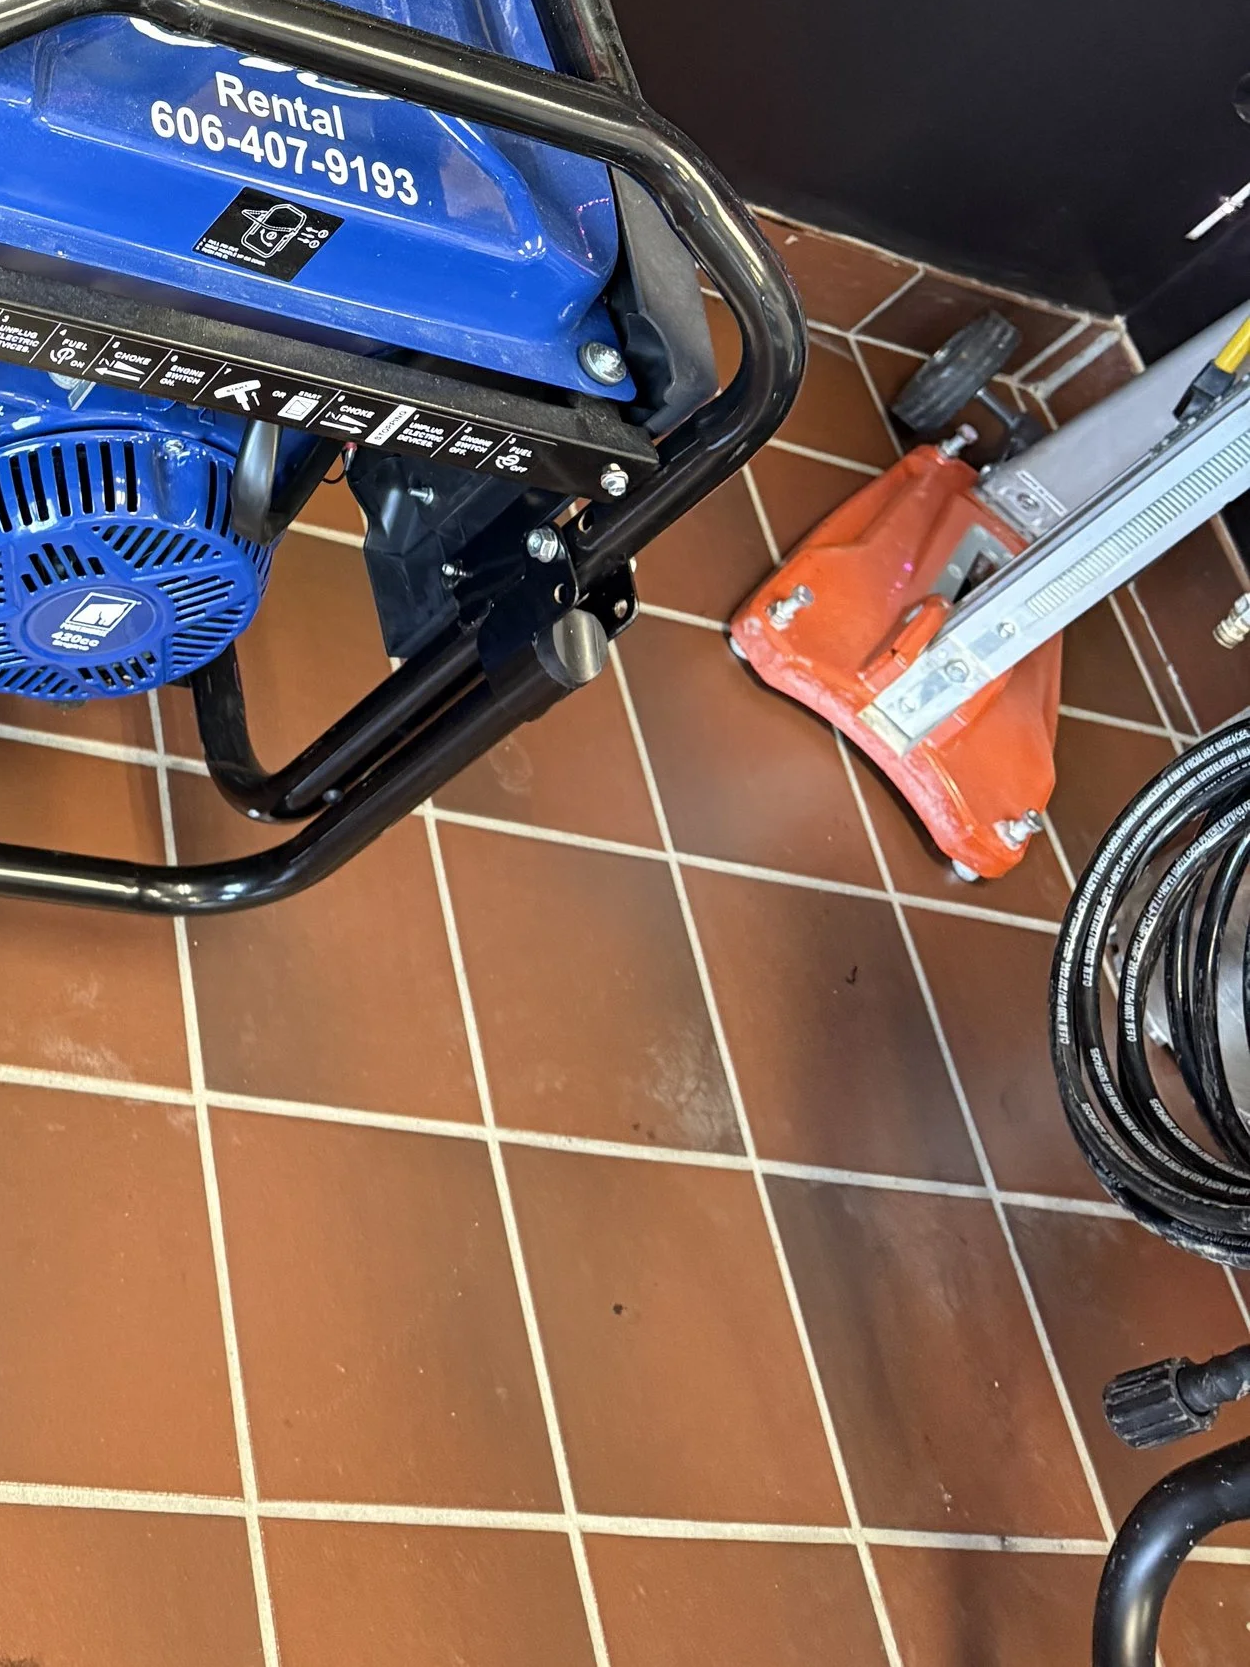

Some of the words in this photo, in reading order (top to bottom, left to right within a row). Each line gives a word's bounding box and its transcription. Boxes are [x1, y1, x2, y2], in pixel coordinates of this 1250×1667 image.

[215, 71, 345, 141] Rental
[150, 99, 419, 206] 606-407-9193
[2, 315, 10, 323] 3
[0, 324, 38, 339] UNPLUG
[62, 339, 88, 351] FUEL
[70, 360, 85, 369] ON
[114, 351, 152, 365] CHOKE
[165, 372, 201, 384] SWITCH
[170, 364, 206, 378] ENGINE
[272, 390, 287, 399] OR
[298, 391, 322, 400] START
[340, 405, 375, 419] CHOKE
[374, 410, 407, 441] STOPPING
[409, 422, 444, 435] UNPLUG
[403, 428, 444, 442] ELECTRIC
[460, 435, 493, 447] ENGINE
[455, 441, 488, 454] SWITCH
[509, 446, 532, 458] FUEL
[510, 465, 528, 473] OFF
[51, 631, 100, 647] 420cc
[1167, 765, 1187, 784] AWAY
[1183, 753, 1203, 770] FROM
[1200, 744, 1216, 758] HOT
[1198, 822, 1222, 845] PATENT
[1102, 1081, 1115, 1097] HOT
[1108, 1095, 1125, 1115] FROM
